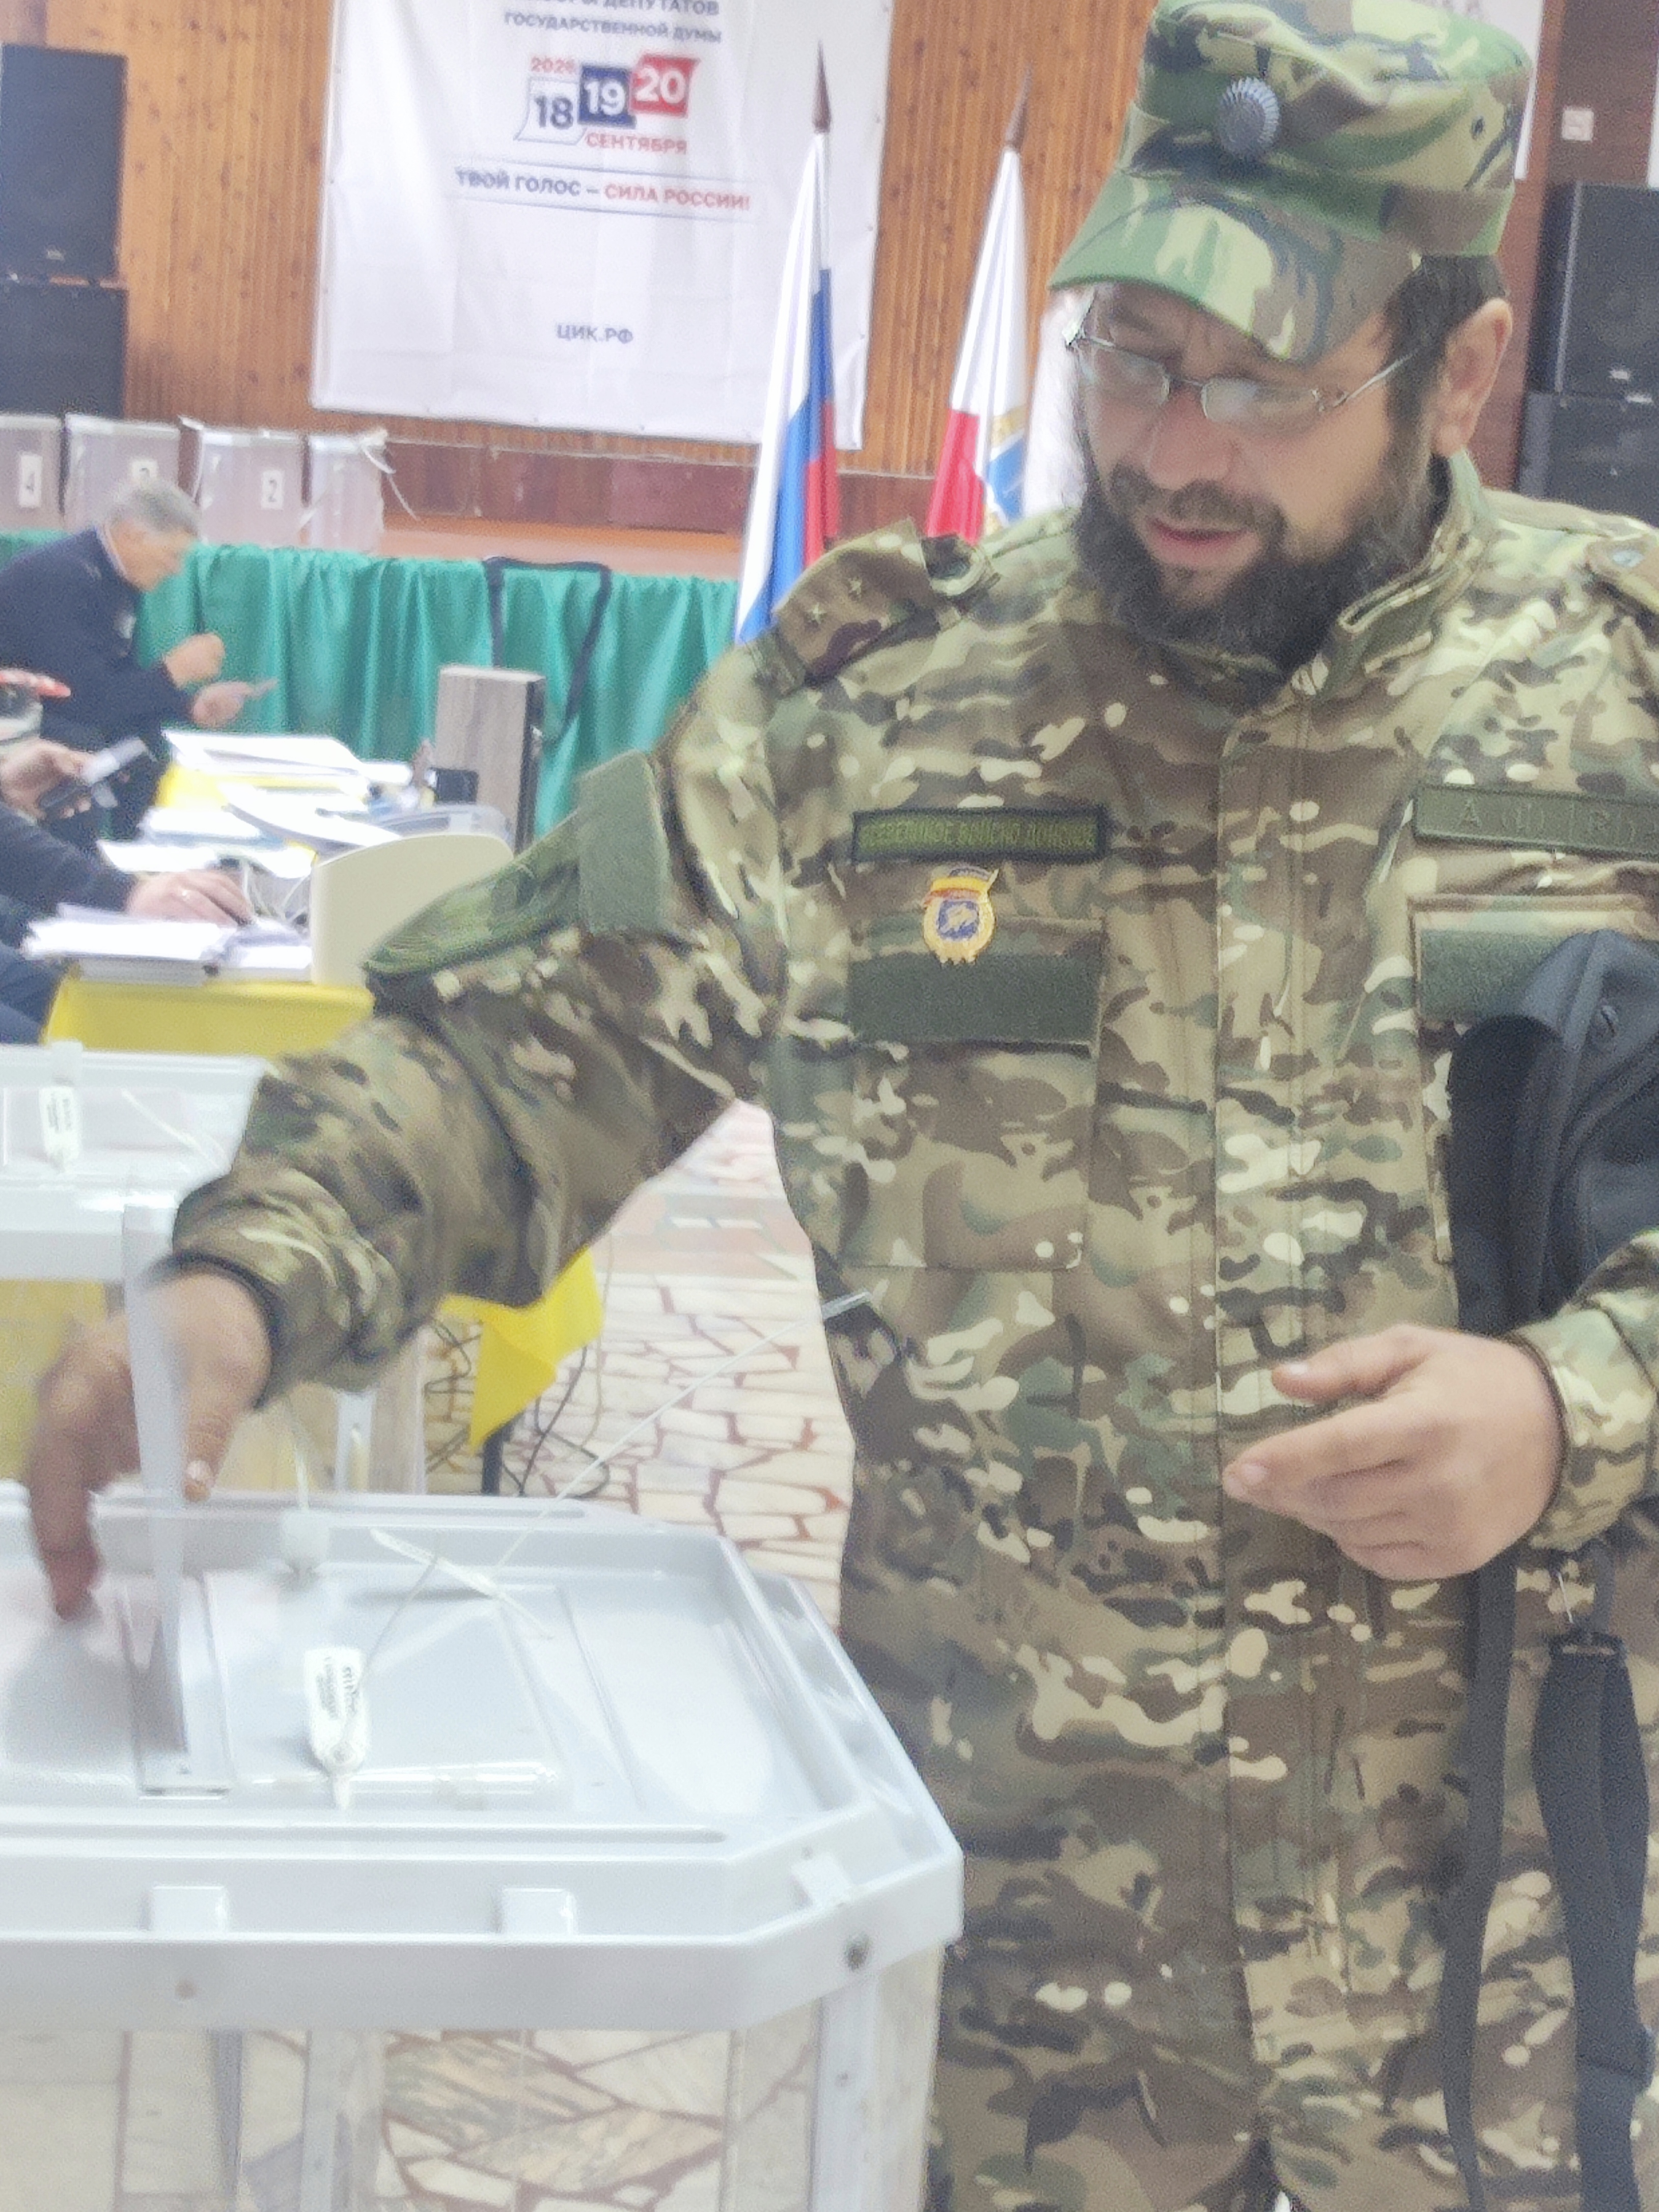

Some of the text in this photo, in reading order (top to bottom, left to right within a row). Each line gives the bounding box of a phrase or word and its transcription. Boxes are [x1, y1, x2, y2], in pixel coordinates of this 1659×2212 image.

[504, 12, 722, 43] ГОСУДАРСТВЕННОЙ ДУМЫ
[535, 68, 686, 129] 18 19 20
[586, 132, 687, 154] СЕНТЯБРЯ
[456, 167, 509, 189] ТВОЙ
[515, 178, 581, 197] ГОЛОС
[604, 184, 658, 203] СИЛА
[665, 190, 750, 210] РОССИИ!
[557, 324, 633, 344] ЦИК.РФ
